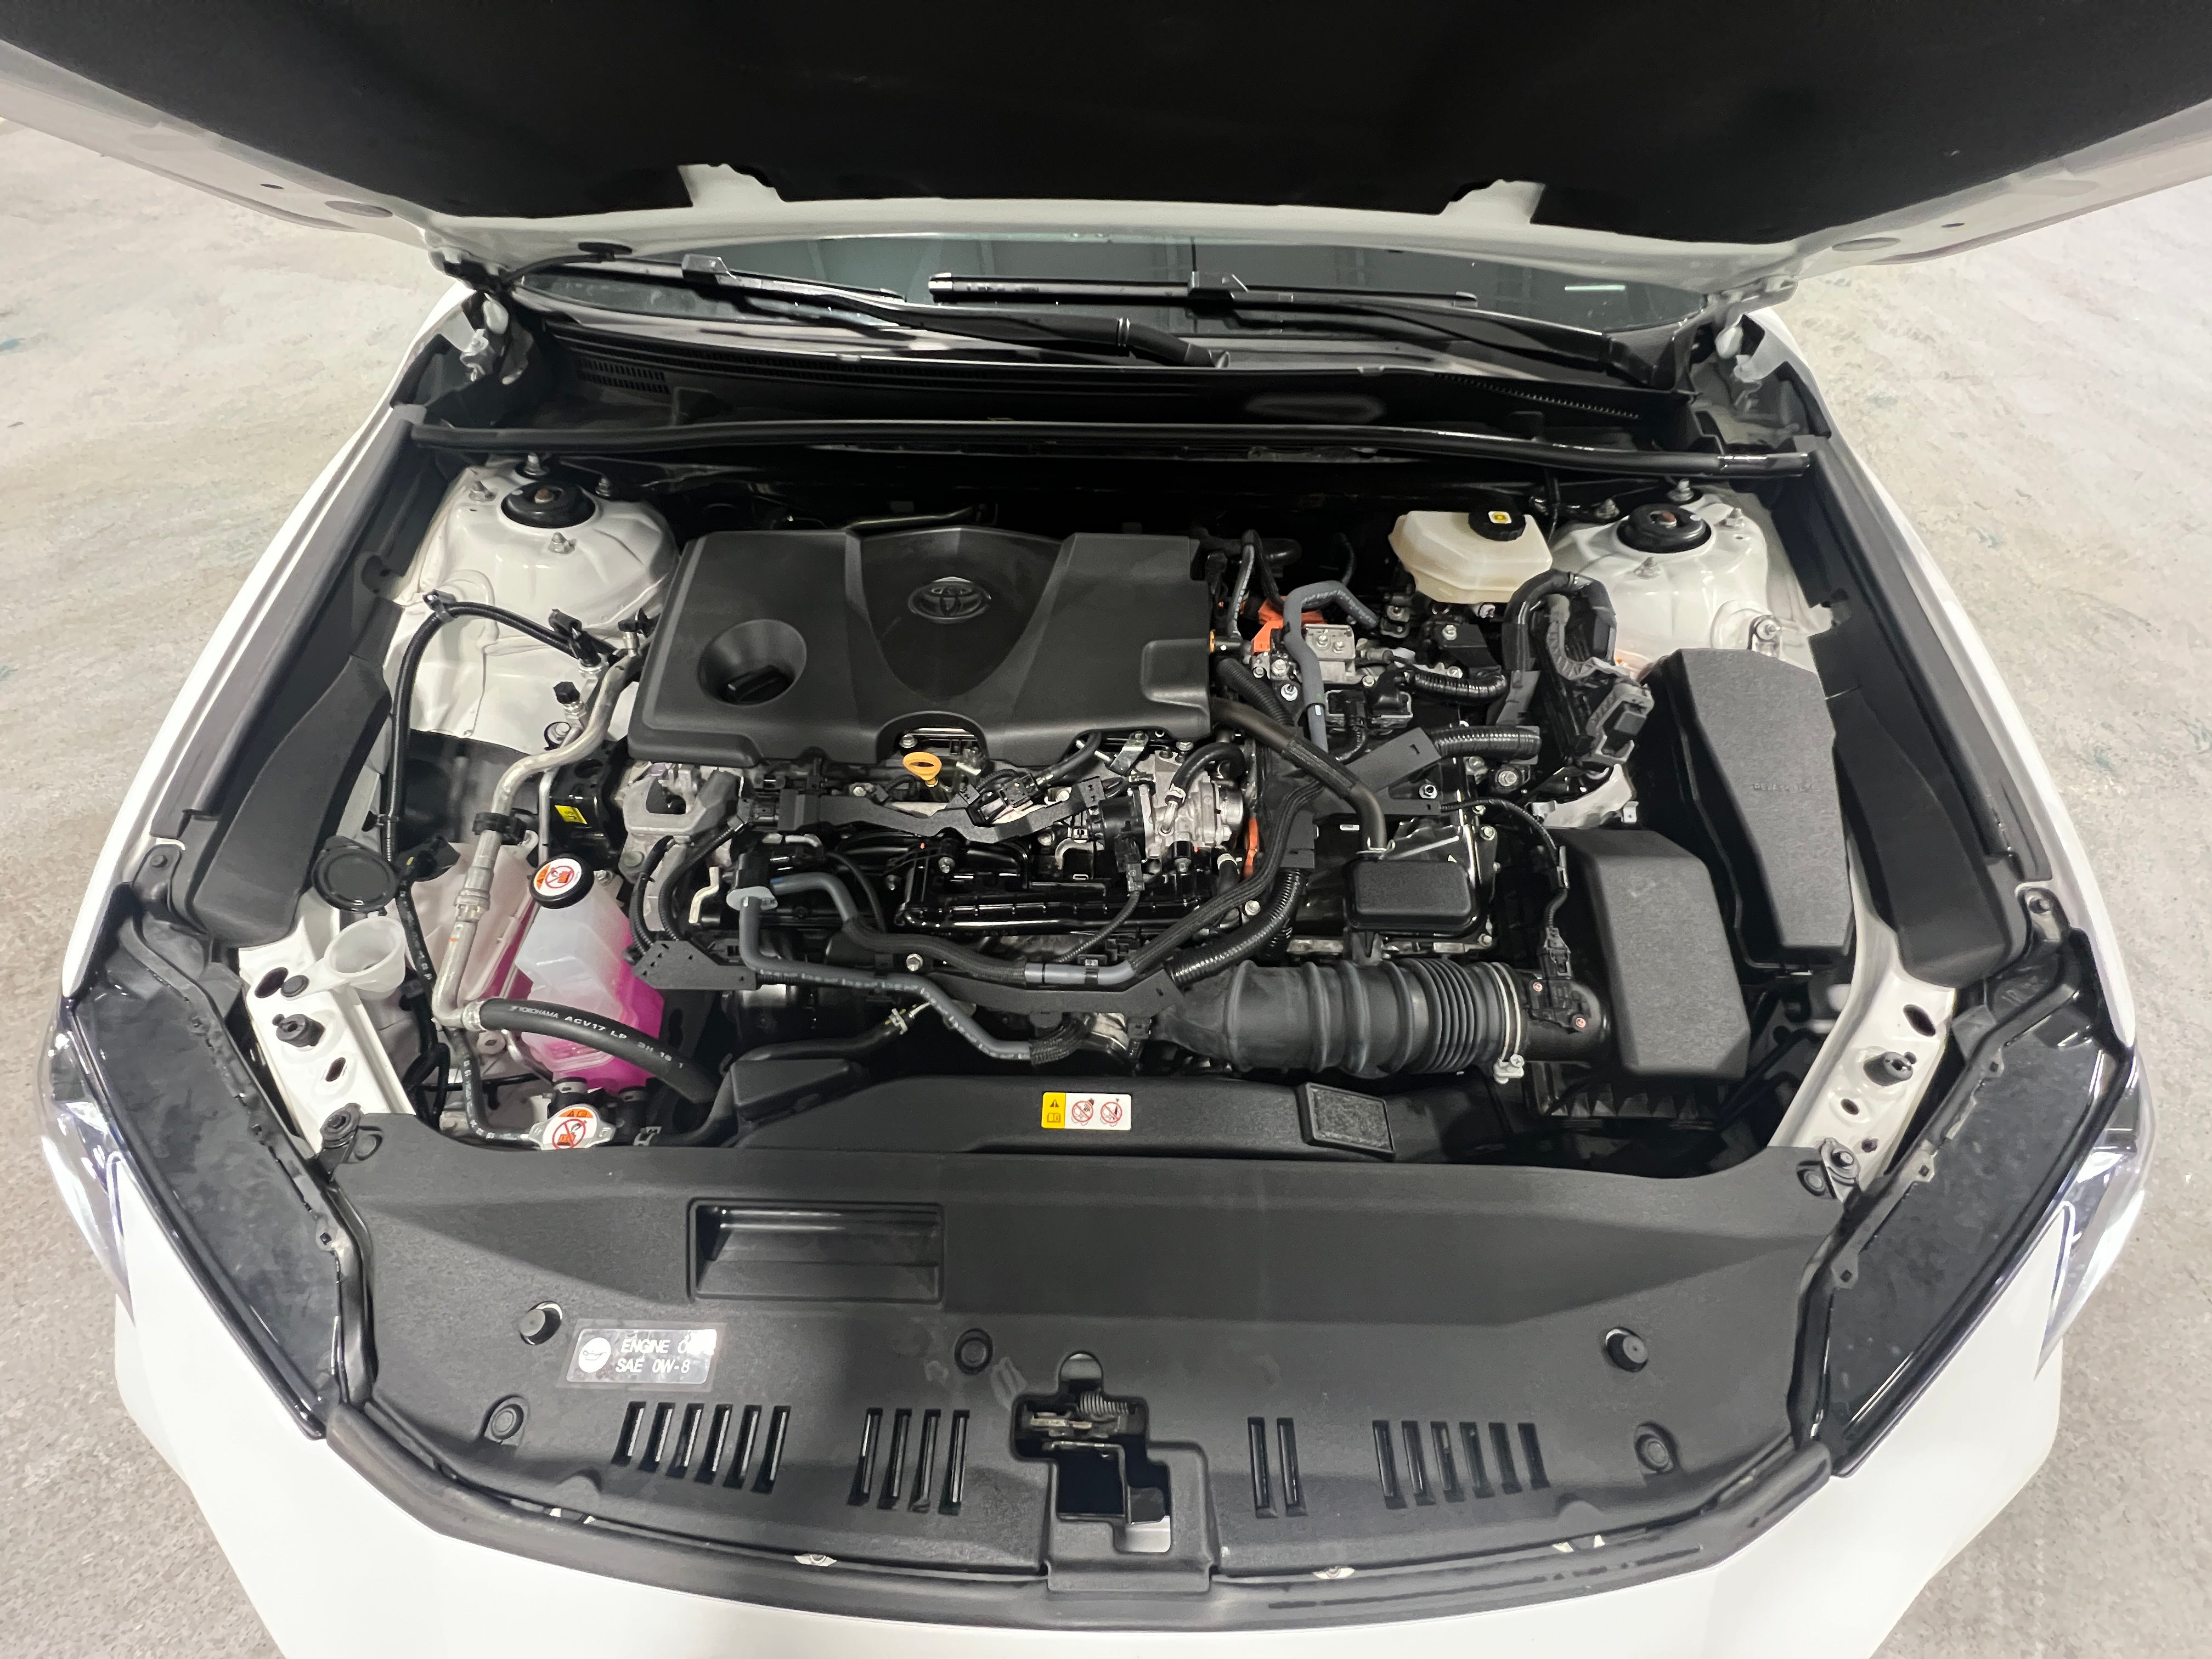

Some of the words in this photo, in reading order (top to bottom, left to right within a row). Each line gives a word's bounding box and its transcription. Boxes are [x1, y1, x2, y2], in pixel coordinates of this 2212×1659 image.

[509, 1006, 558, 1019] YOKOHAMA
[565, 1016, 606, 1031] ACV17
[610, 1030, 627, 1039] LP
[620, 1339, 670, 1353] ENGINE
[616, 1358, 645, 1373] SAE
[652, 1358, 691, 1373] 0W-8
